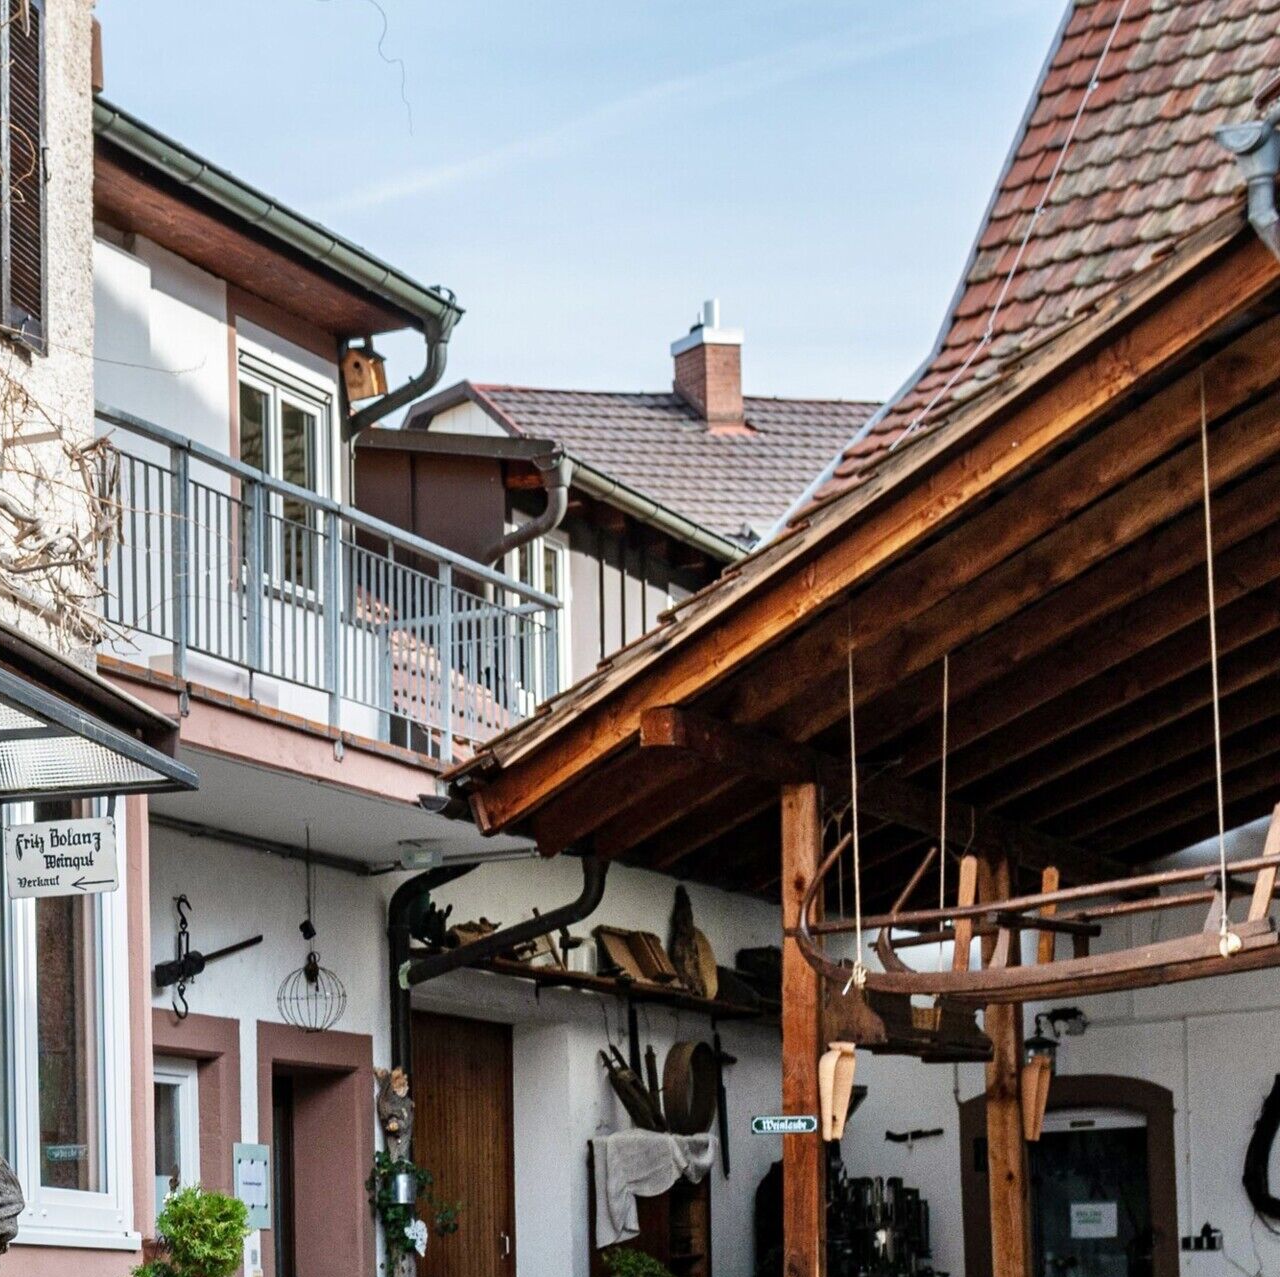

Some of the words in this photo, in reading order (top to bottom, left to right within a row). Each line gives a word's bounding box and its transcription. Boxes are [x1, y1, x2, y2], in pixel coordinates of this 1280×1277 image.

[16, 834, 44, 861] Fritz
[49, 827, 102, 852] Bolanz
[44, 851, 94, 870] Weingut
[17, 875, 60, 888] Verkauf
